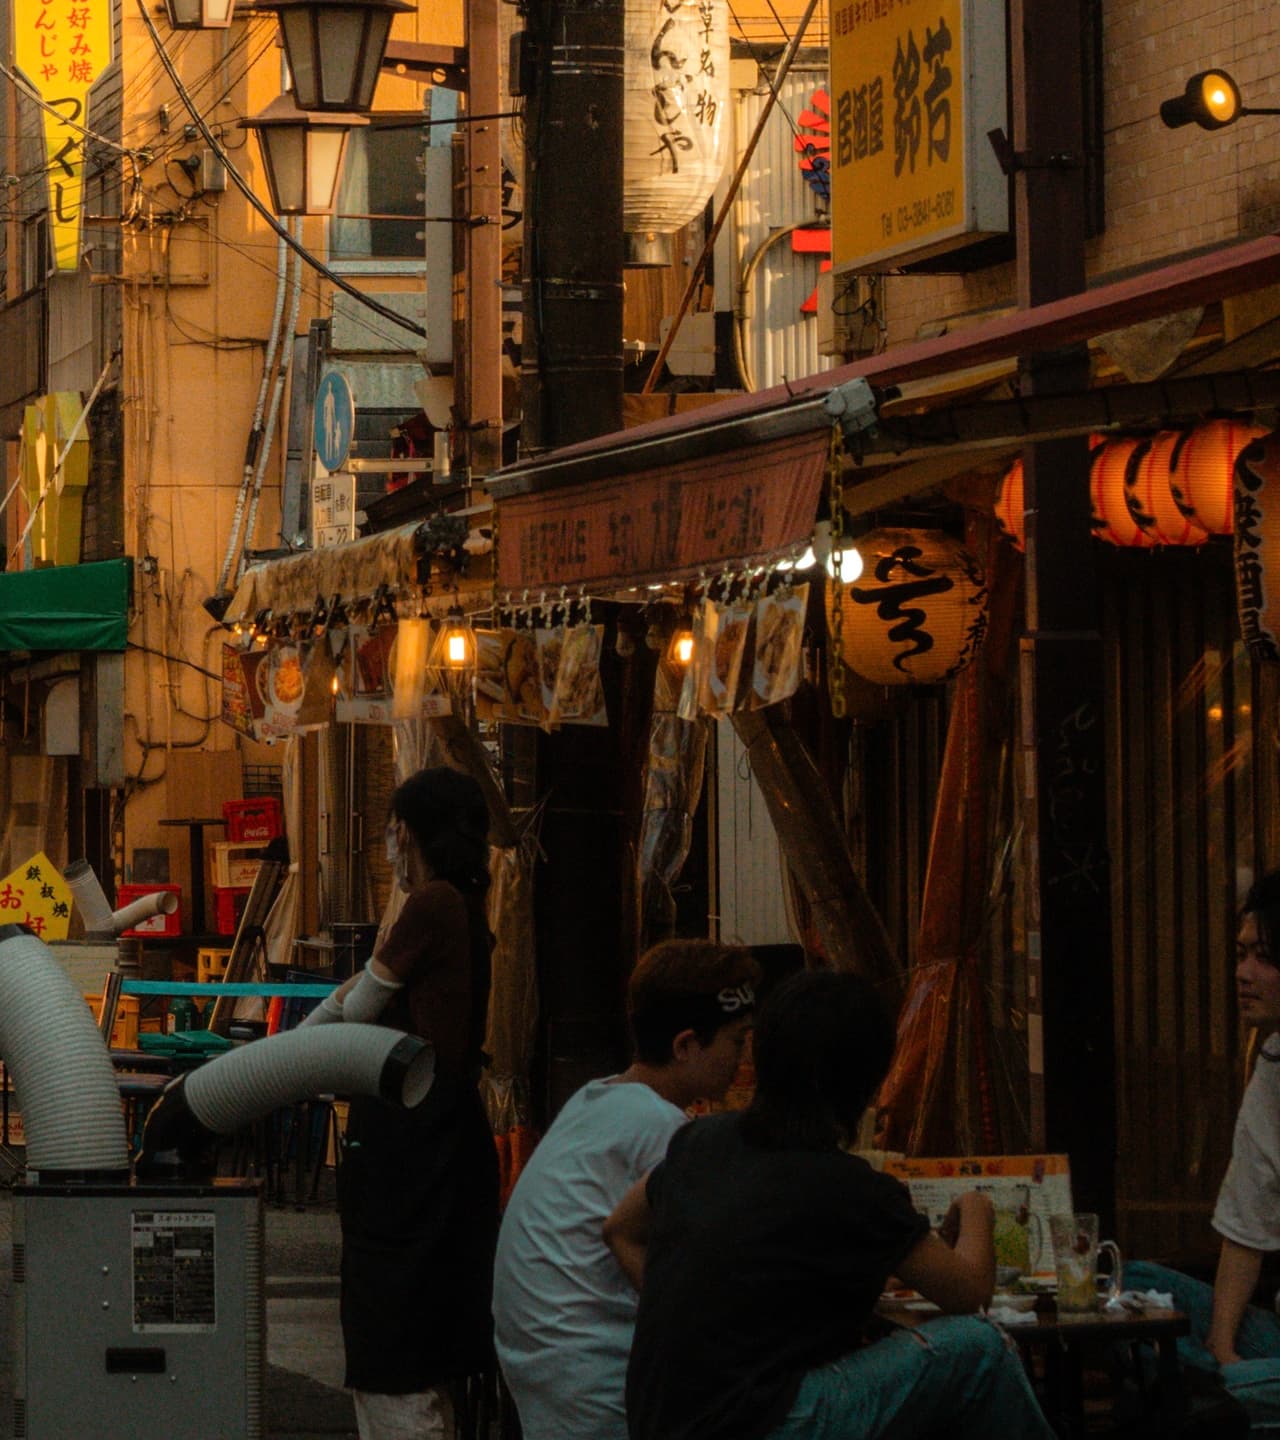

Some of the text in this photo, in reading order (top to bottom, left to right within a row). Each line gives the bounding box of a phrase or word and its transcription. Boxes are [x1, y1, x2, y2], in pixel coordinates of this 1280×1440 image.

[46, 96, 85, 224] つくし
[837, 75, 884, 169] 居酒屋
